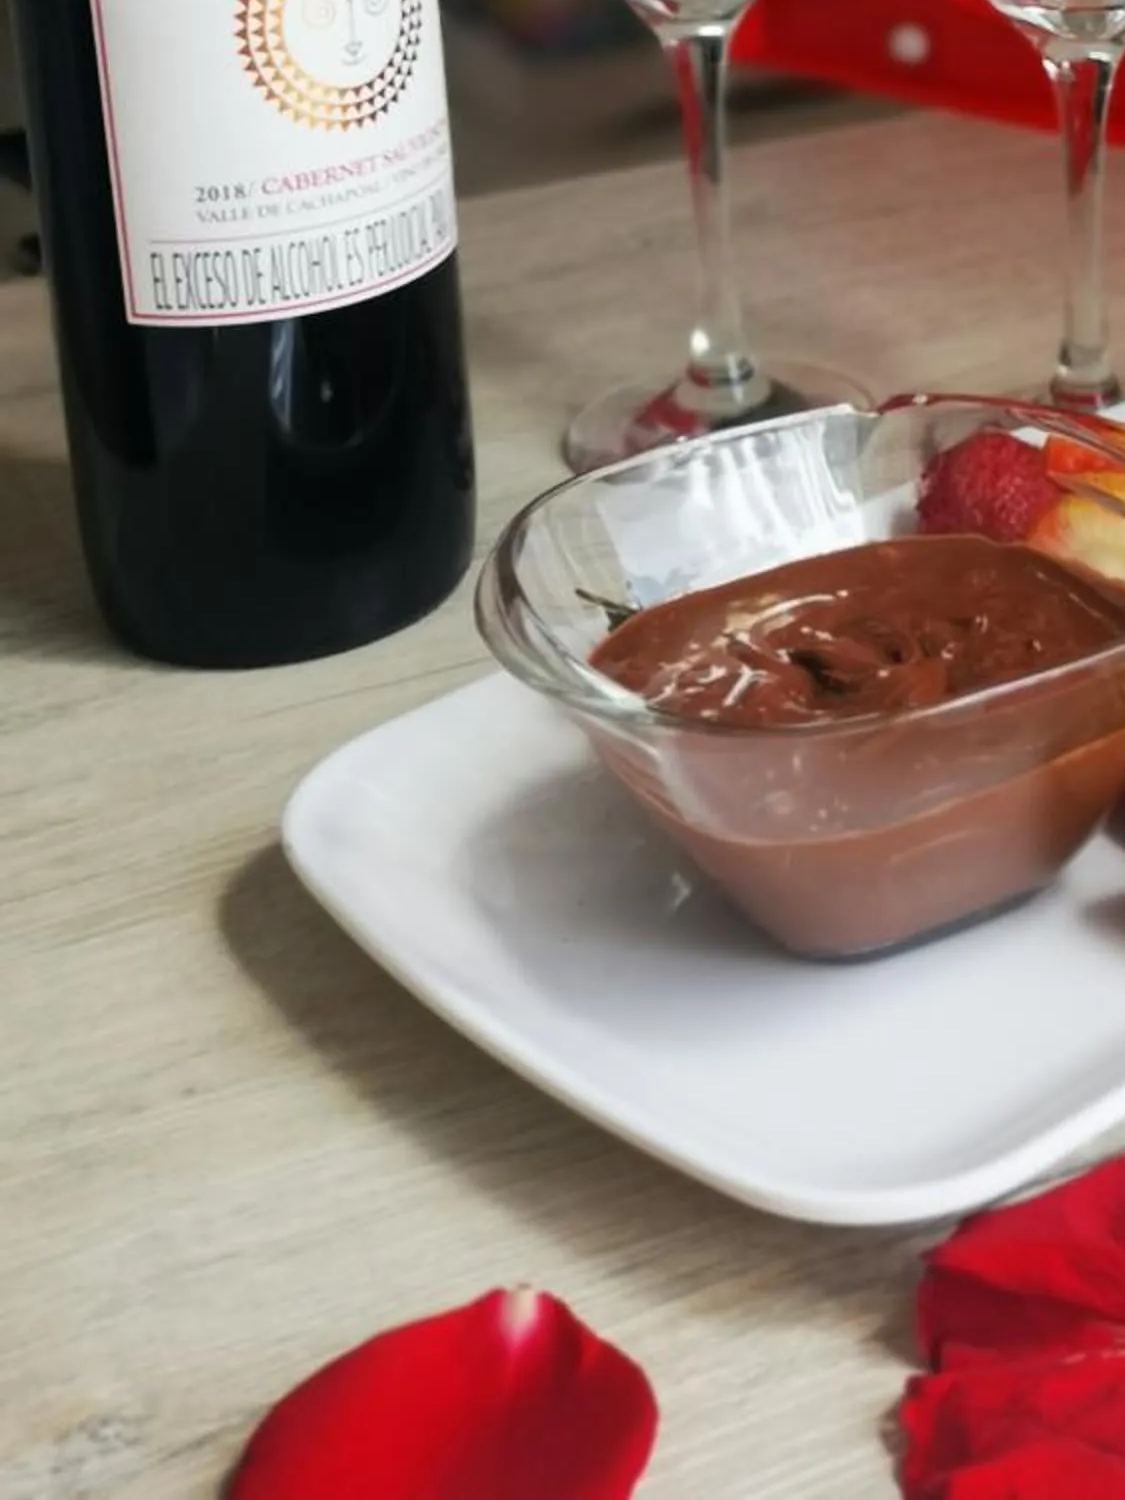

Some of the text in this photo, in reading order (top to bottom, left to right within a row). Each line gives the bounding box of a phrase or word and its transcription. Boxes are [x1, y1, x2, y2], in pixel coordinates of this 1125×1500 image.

[261, 153, 379, 196] CABERNET
[196, 206, 250, 224] VALLE
[257, 203, 280, 219] DE
[150, 252, 173, 311] EL
[173, 250, 240, 311] EXCESO
[242, 247, 267, 306] DE
[271, 235, 344, 303] ALCOHOL
[345, 227, 366, 287] ES
